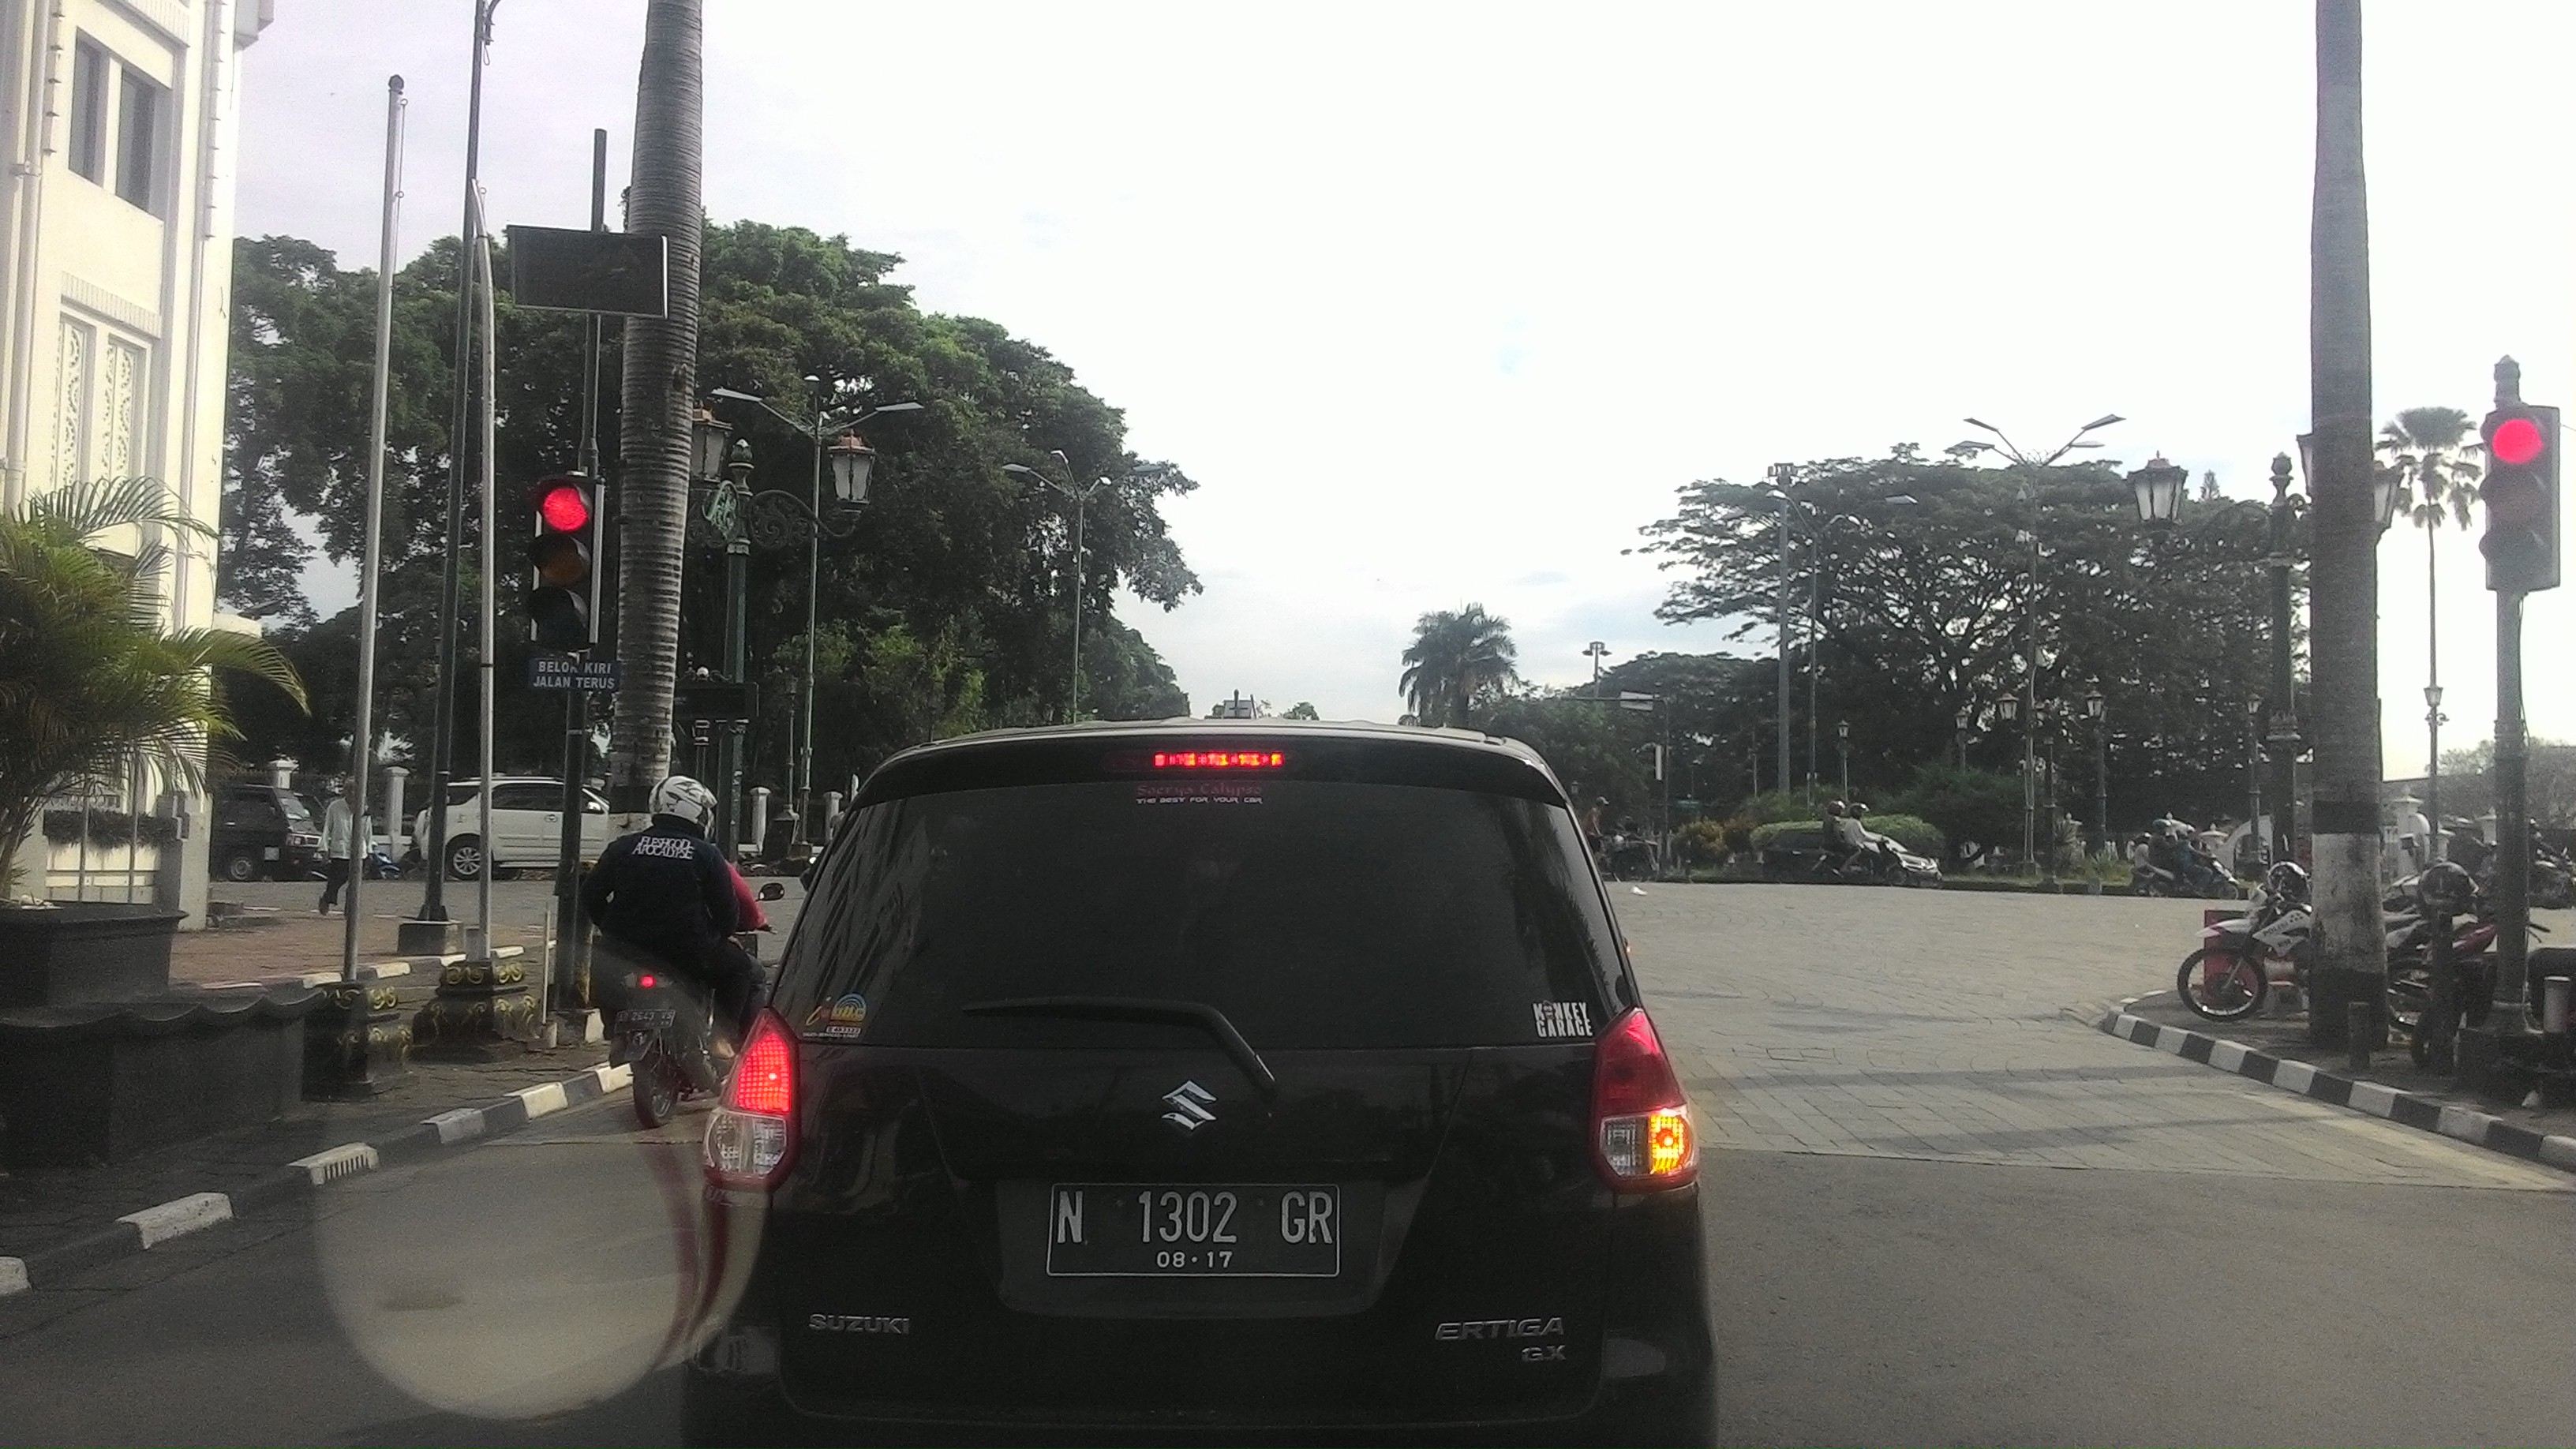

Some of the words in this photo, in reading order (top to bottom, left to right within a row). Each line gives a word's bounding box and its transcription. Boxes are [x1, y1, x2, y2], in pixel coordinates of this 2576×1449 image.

[584, 662, 612, 674] KIRI
[533, 676, 571, 687] JALAN
[576, 677, 615, 689] TERUS
[1536, 1018, 1593, 1038] GARAGE
[1057, 1190, 1084, 1244] N
[1138, 1190, 1237, 1243] 1302
[1280, 1190, 1334, 1245] GR
[809, 1313, 910, 1334] SUZUKI
[1435, 1316, 1564, 1340] ERTIGA
[1522, 1345, 1566, 1361] GX
